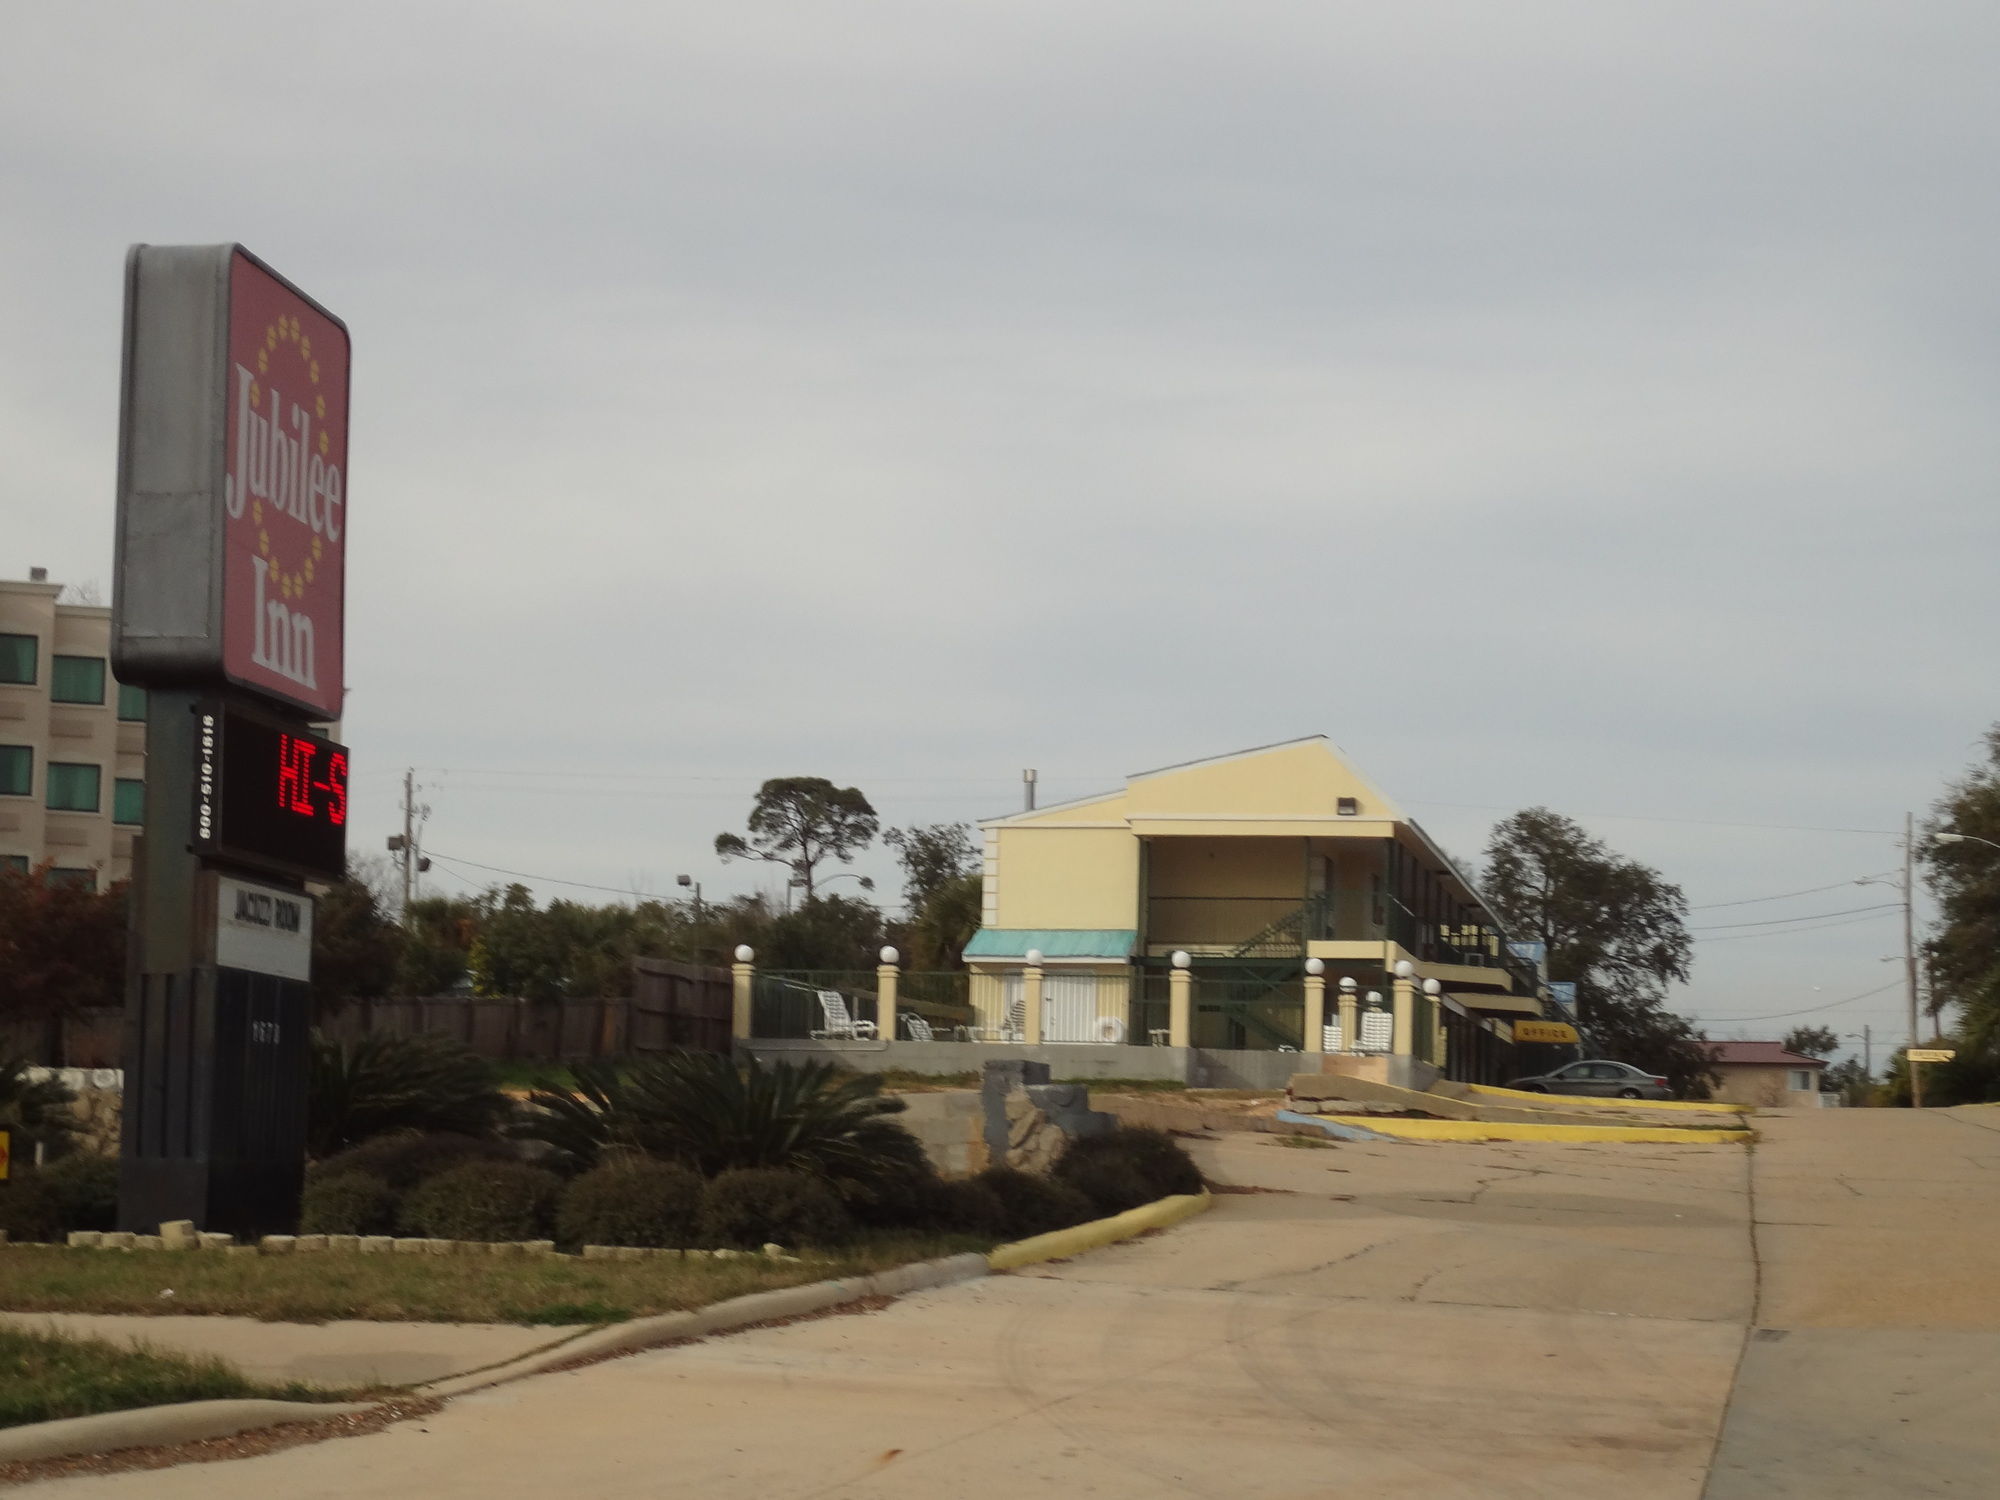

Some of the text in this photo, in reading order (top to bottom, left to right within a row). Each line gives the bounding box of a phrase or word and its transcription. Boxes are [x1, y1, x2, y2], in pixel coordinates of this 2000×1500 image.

[226, 363, 341, 542] Jubilee
[252, 555, 316, 690] Inn
[1522, 1027, 1568, 1039] OFFICE
